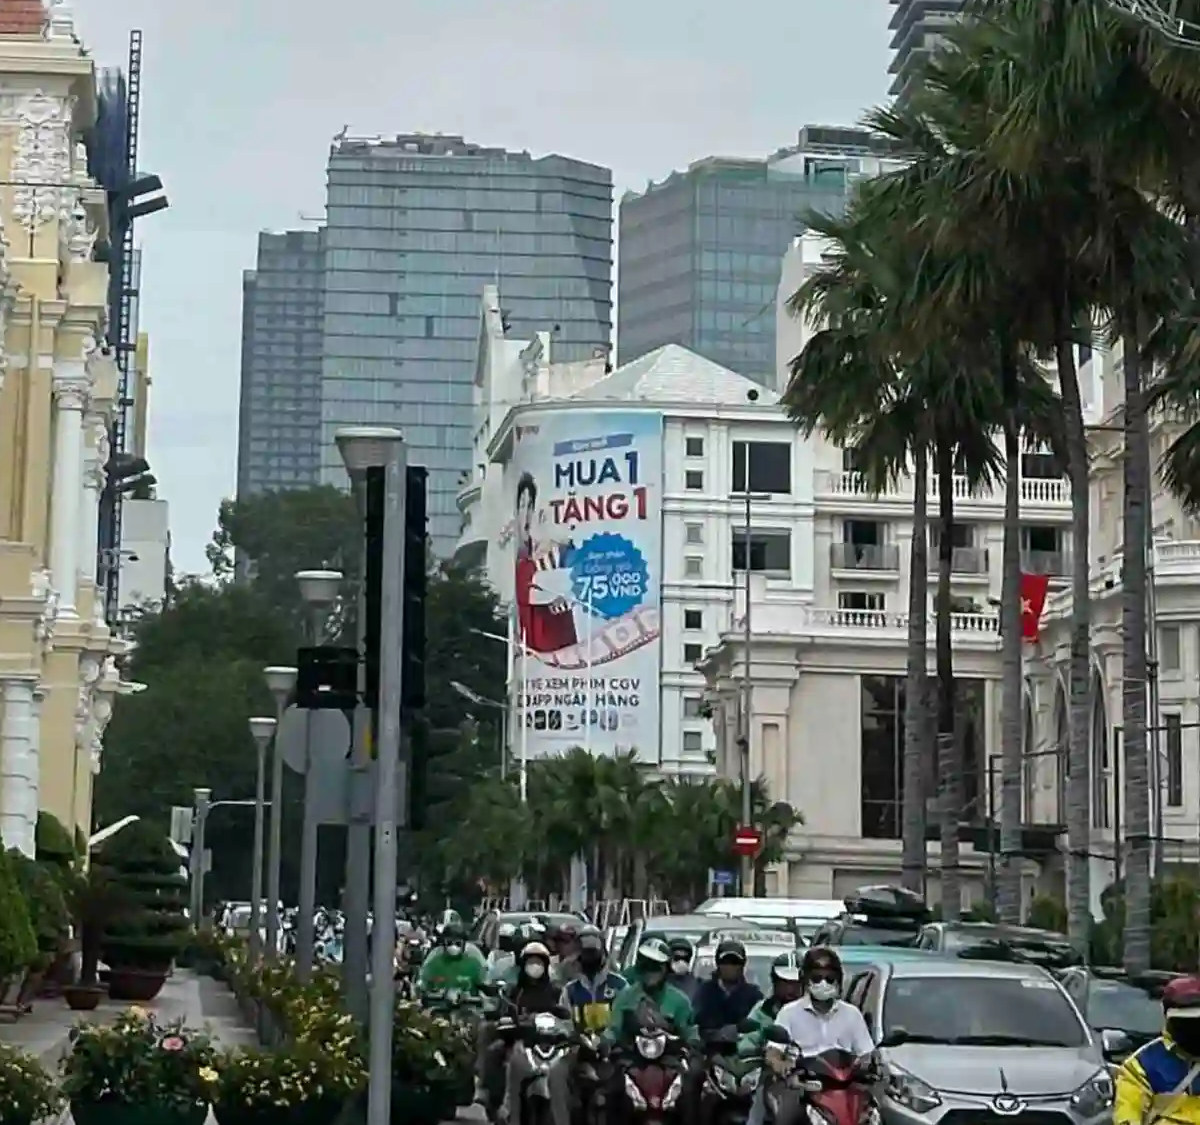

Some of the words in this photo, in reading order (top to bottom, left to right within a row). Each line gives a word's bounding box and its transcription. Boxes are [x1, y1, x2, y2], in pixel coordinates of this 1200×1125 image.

[555, 458, 621, 488] MUA
[625, 451, 638, 485] 1
[550, 491, 629, 531] TẶNG
[633, 487, 647, 520] 1
[610, 678, 640, 690] CGV
